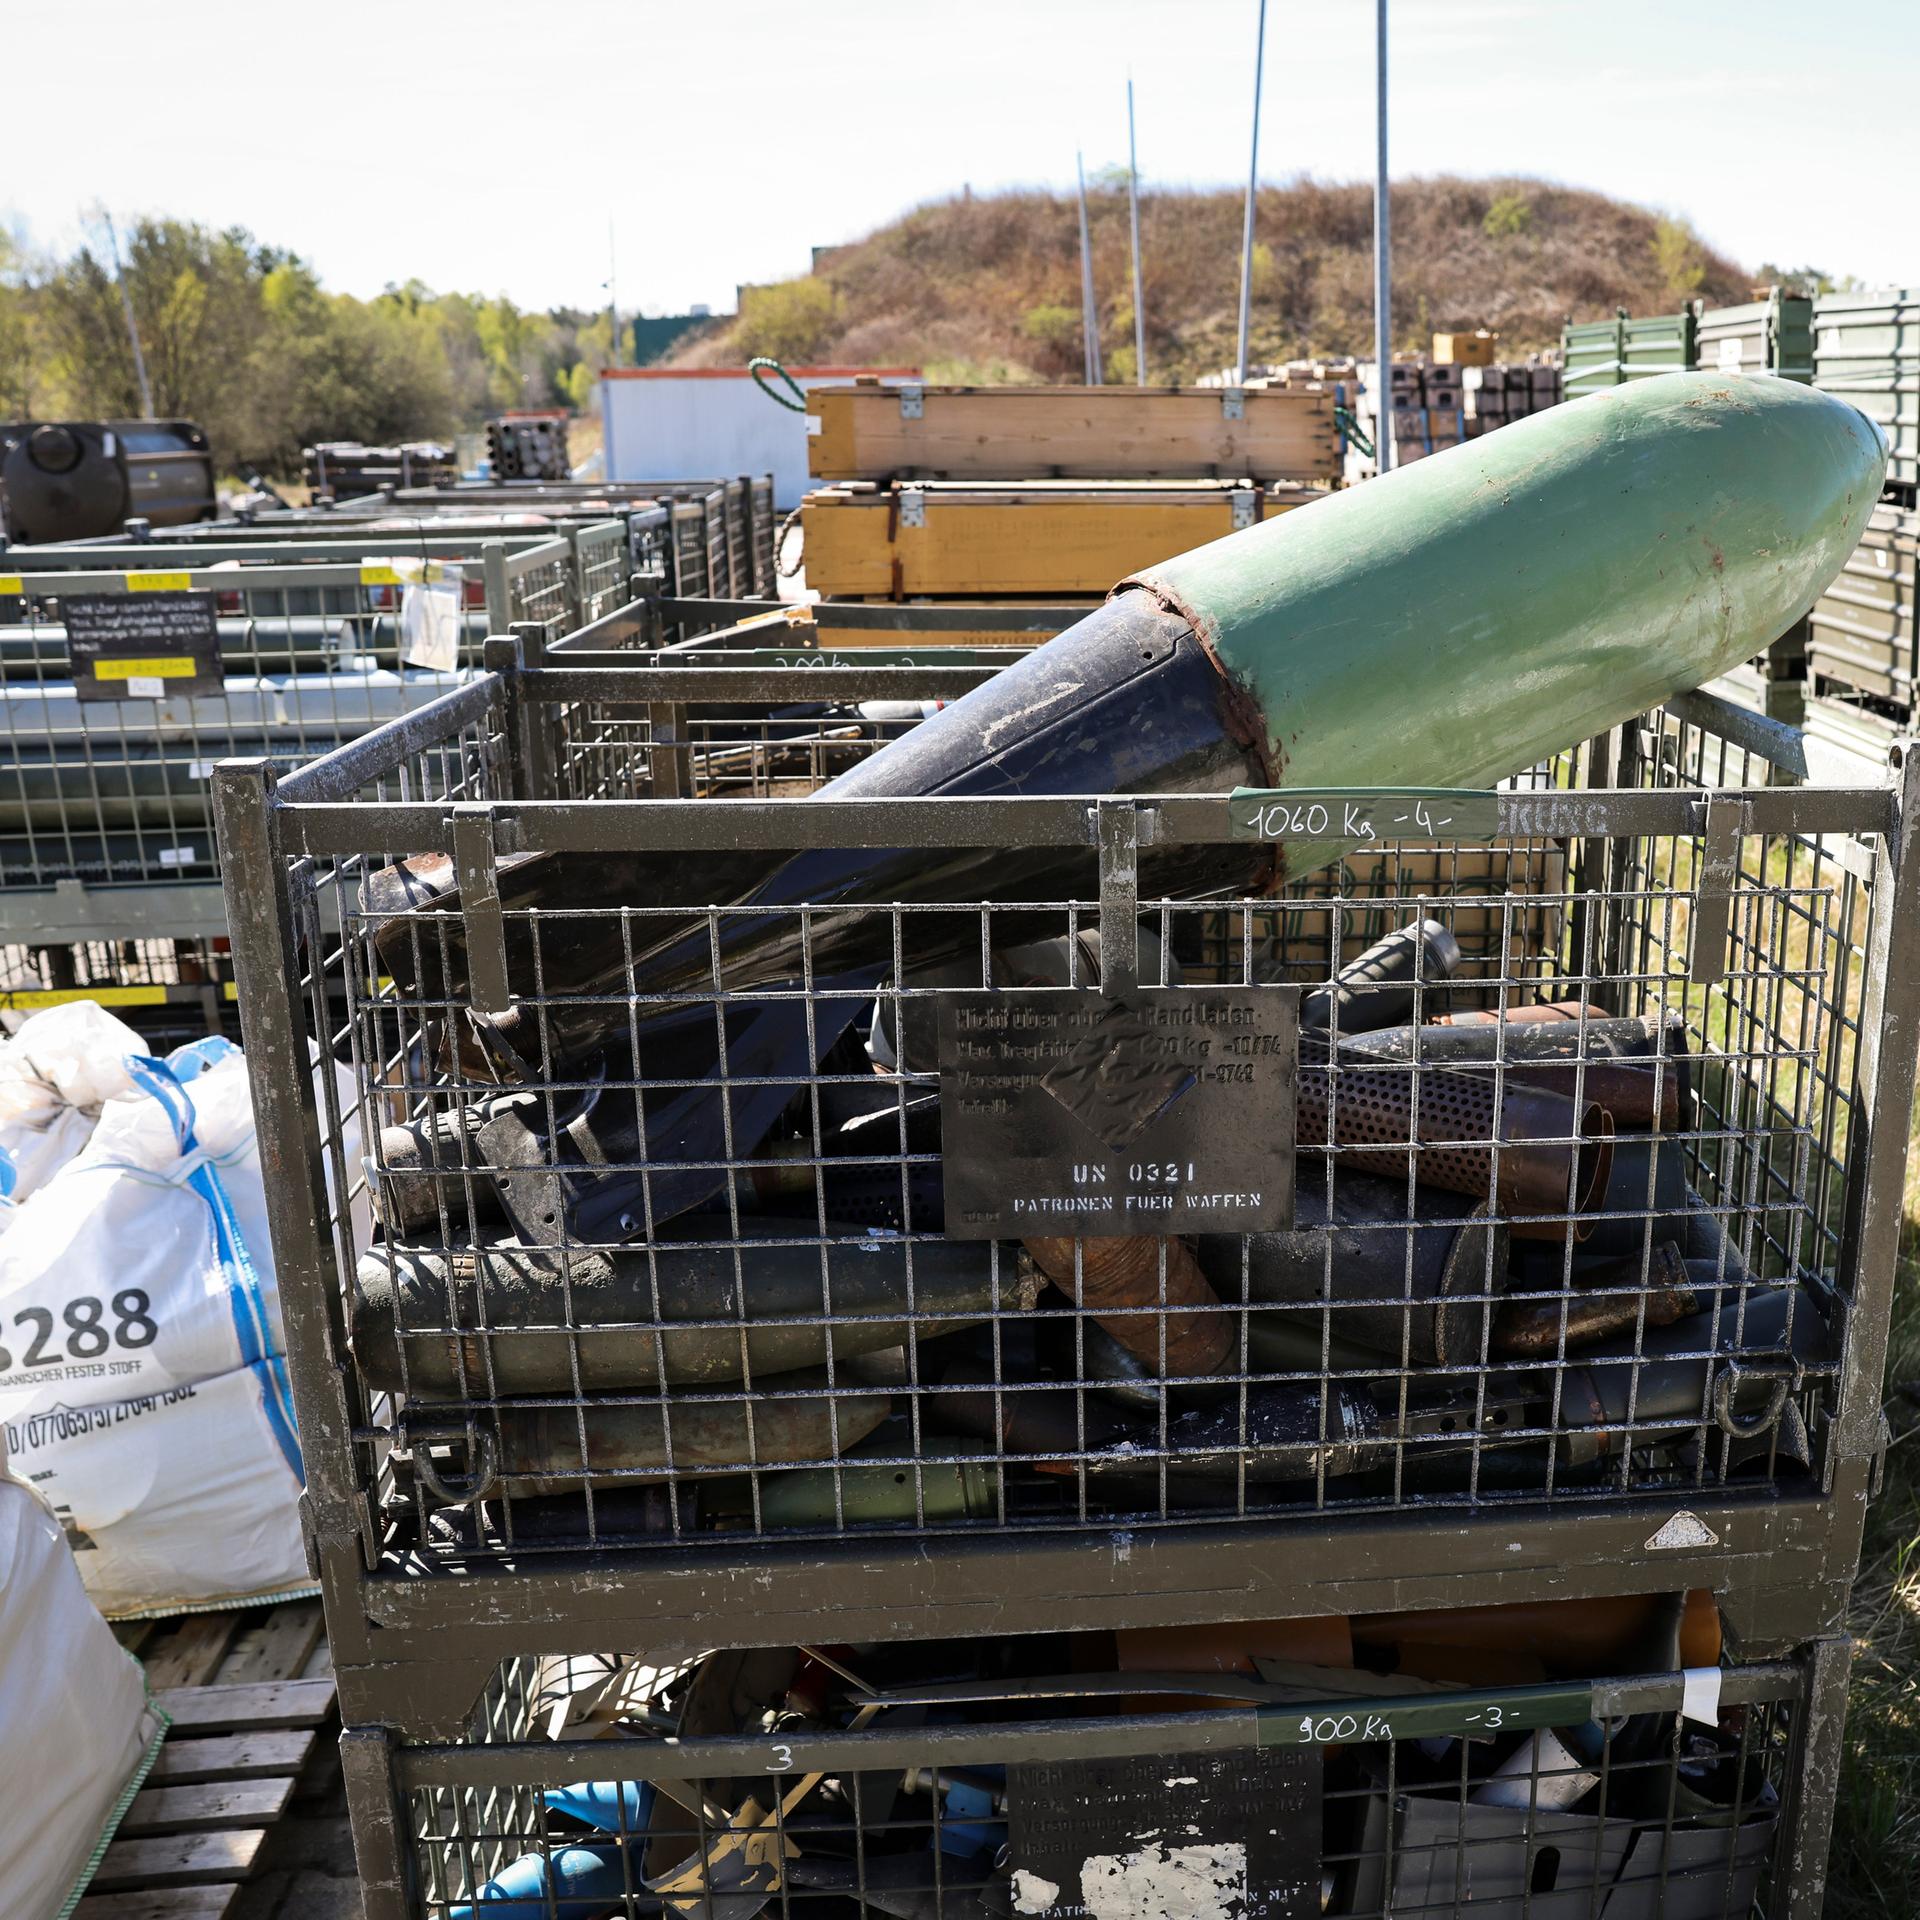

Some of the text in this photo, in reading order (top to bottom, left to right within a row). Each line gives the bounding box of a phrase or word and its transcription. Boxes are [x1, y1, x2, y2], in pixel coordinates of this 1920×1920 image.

[1247, 801, 1453, 841] 1060 Kg -4-
[1073, 1163, 1195, 1183] UN 0321
[1014, 1193, 1261, 1212] PATRONEN FUER WAFFEN
[66, 1363, 105, 1380] FESTER
[109, 1360, 142, 1376] STOFF
[1465, 1706, 1520, 1728] -3-
[765, 1745, 794, 1771] 3
